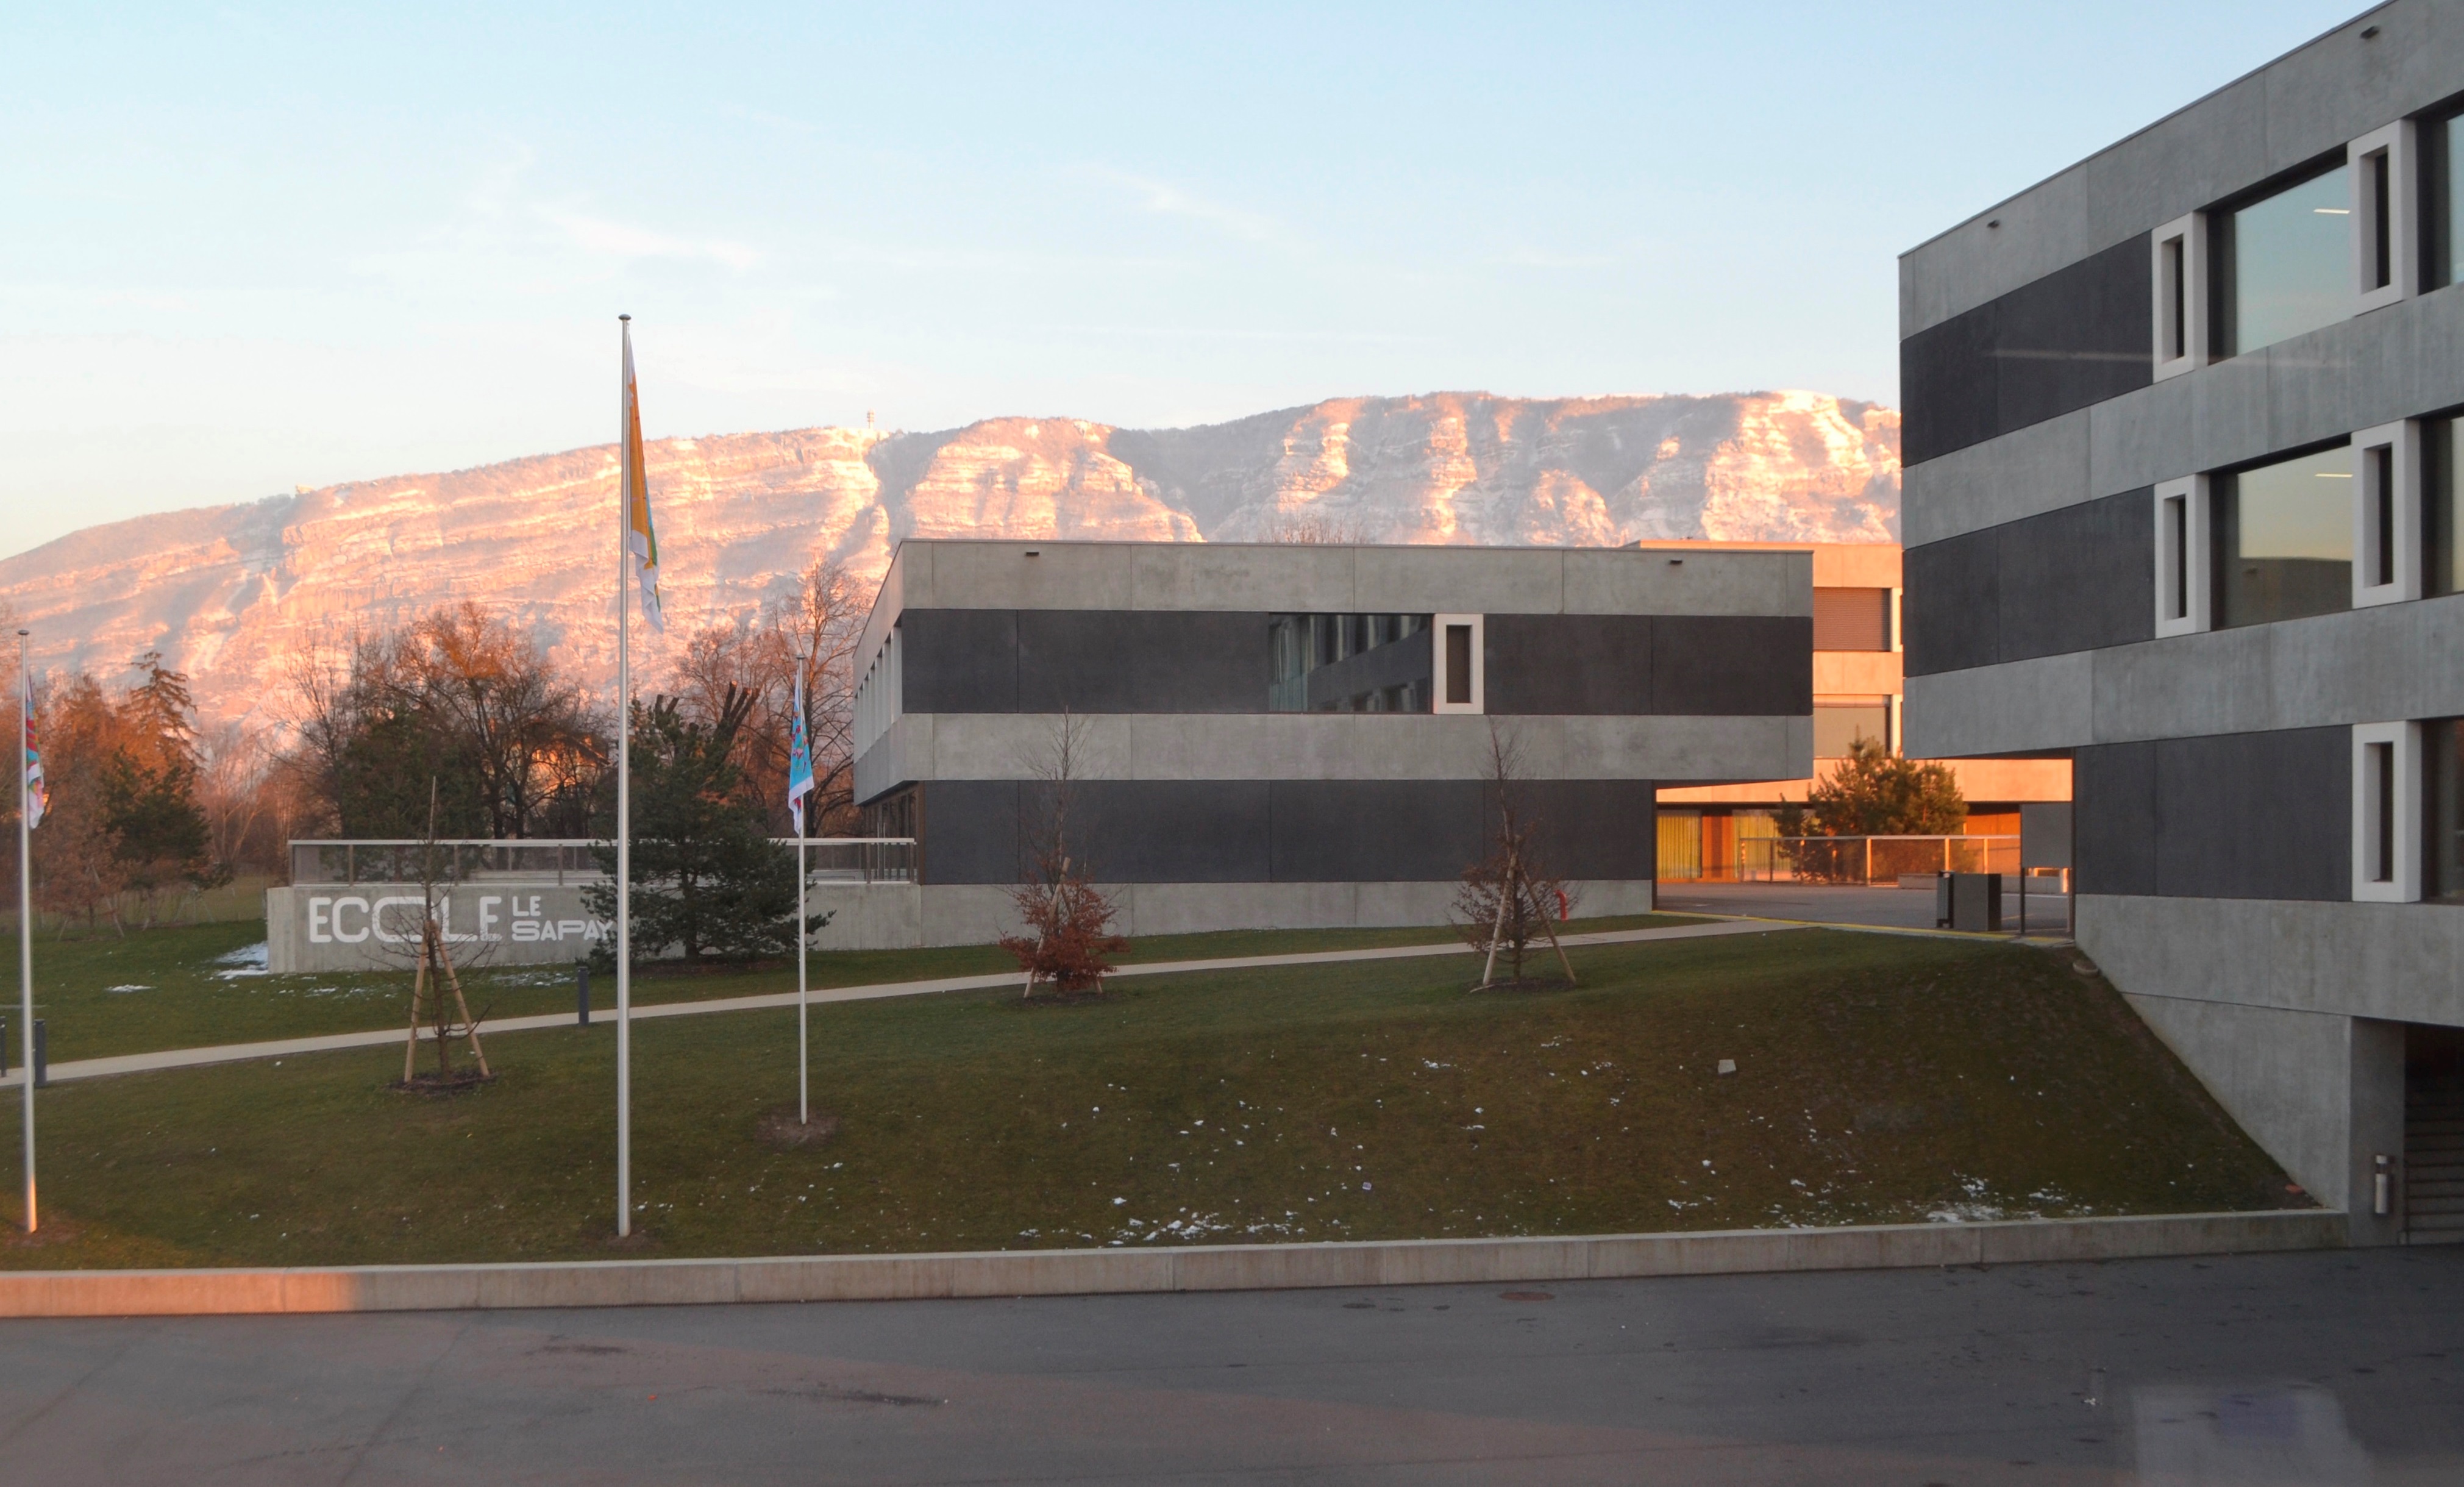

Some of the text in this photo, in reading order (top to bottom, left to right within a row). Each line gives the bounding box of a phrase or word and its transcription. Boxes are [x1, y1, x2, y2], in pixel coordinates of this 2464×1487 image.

[512, 896, 541, 916] LE
[309, 896, 502, 943] ECOLE
[511, 920, 613, 941] SAPAY
